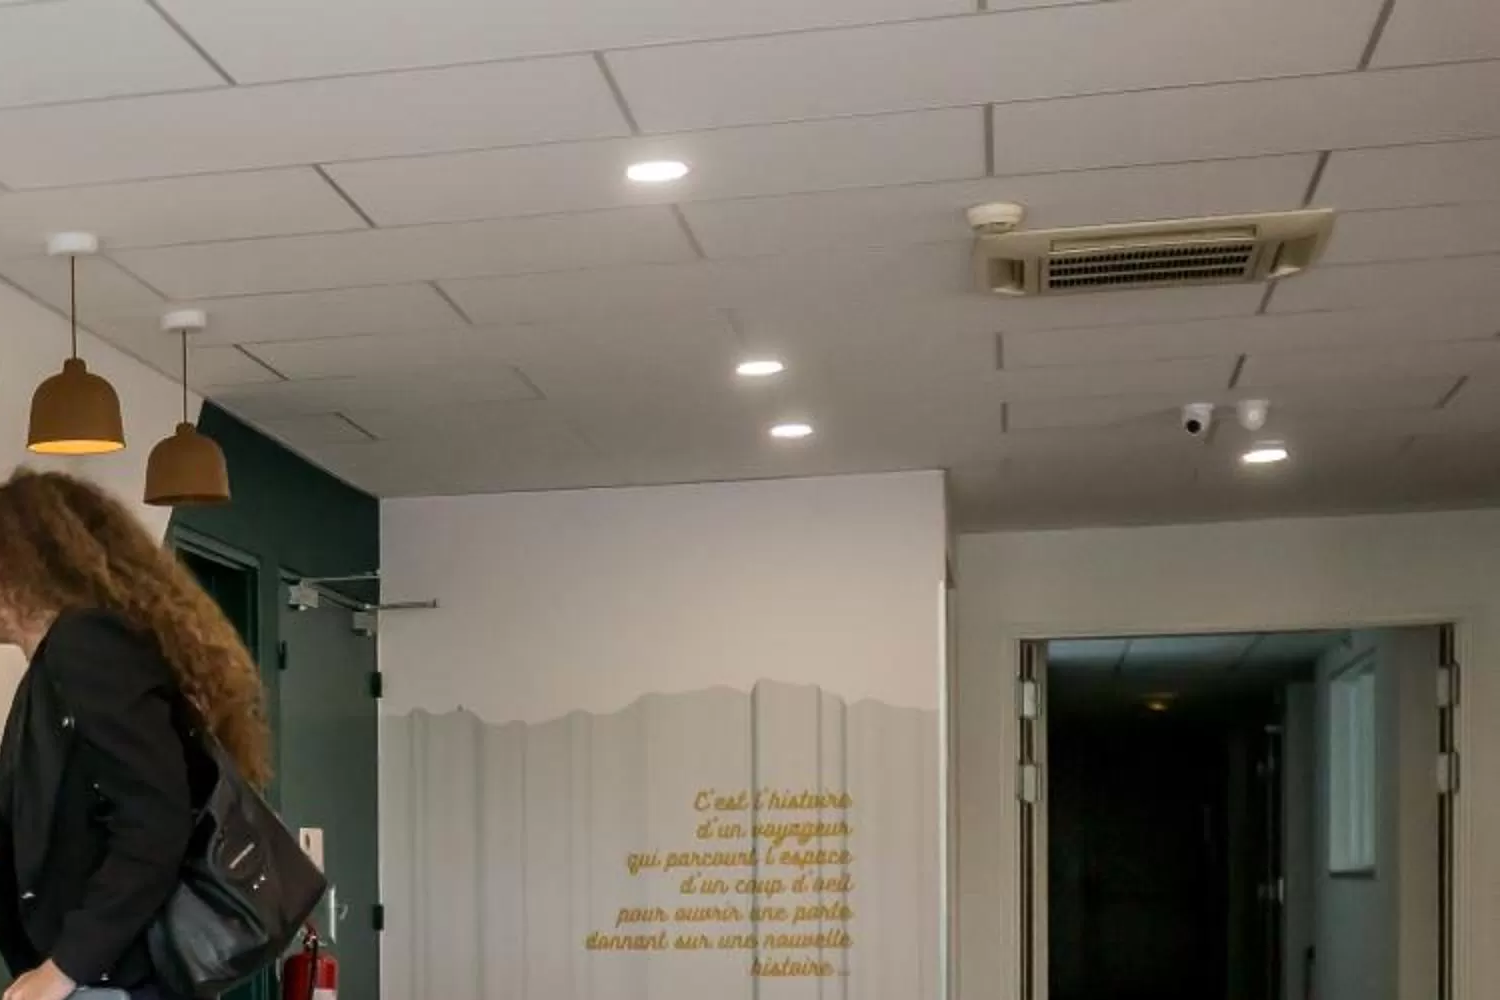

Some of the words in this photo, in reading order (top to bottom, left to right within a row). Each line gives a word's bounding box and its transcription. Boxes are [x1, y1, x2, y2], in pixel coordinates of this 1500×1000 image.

[694, 788, 749, 811] C'est
[753, 786, 852, 811] l'histoire
[696, 816, 746, 840] d'un
[752, 821, 852, 846] voyageur
[627, 848, 661, 876] qui
[663, 848, 756, 872] parcourt
[680, 871, 729, 895] d'un
[735, 878, 786, 898] coup
[615, 906, 669, 928] pour
[674, 901, 743, 922] ouvrir
[749, 905, 789, 922] une
[792, 900, 854, 925] porte
[585, 931, 668, 951] donnant
[674, 933, 712, 951] sur
[717, 933, 758, 949] une
[763, 928, 854, 950] nouvelle
